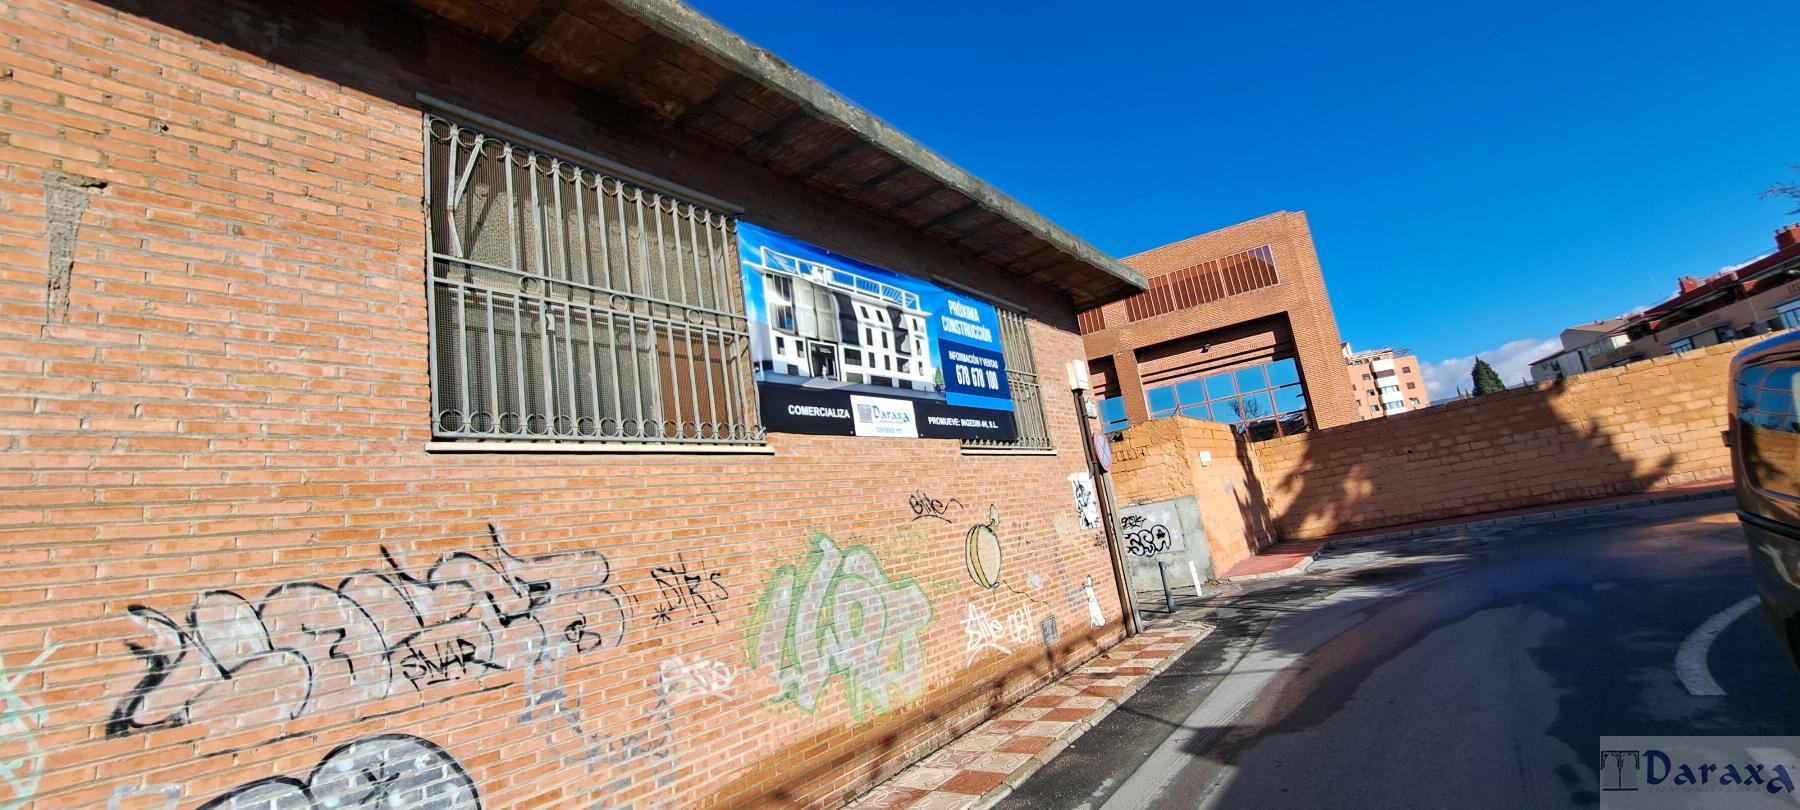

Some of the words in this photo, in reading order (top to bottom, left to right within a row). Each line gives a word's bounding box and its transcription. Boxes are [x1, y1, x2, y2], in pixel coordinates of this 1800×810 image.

[941, 315, 992, 343] CONSTRUCCIÓN
[787, 404, 851, 419] COMERCIALIZA
[872, 405, 911, 423] Daraxa
